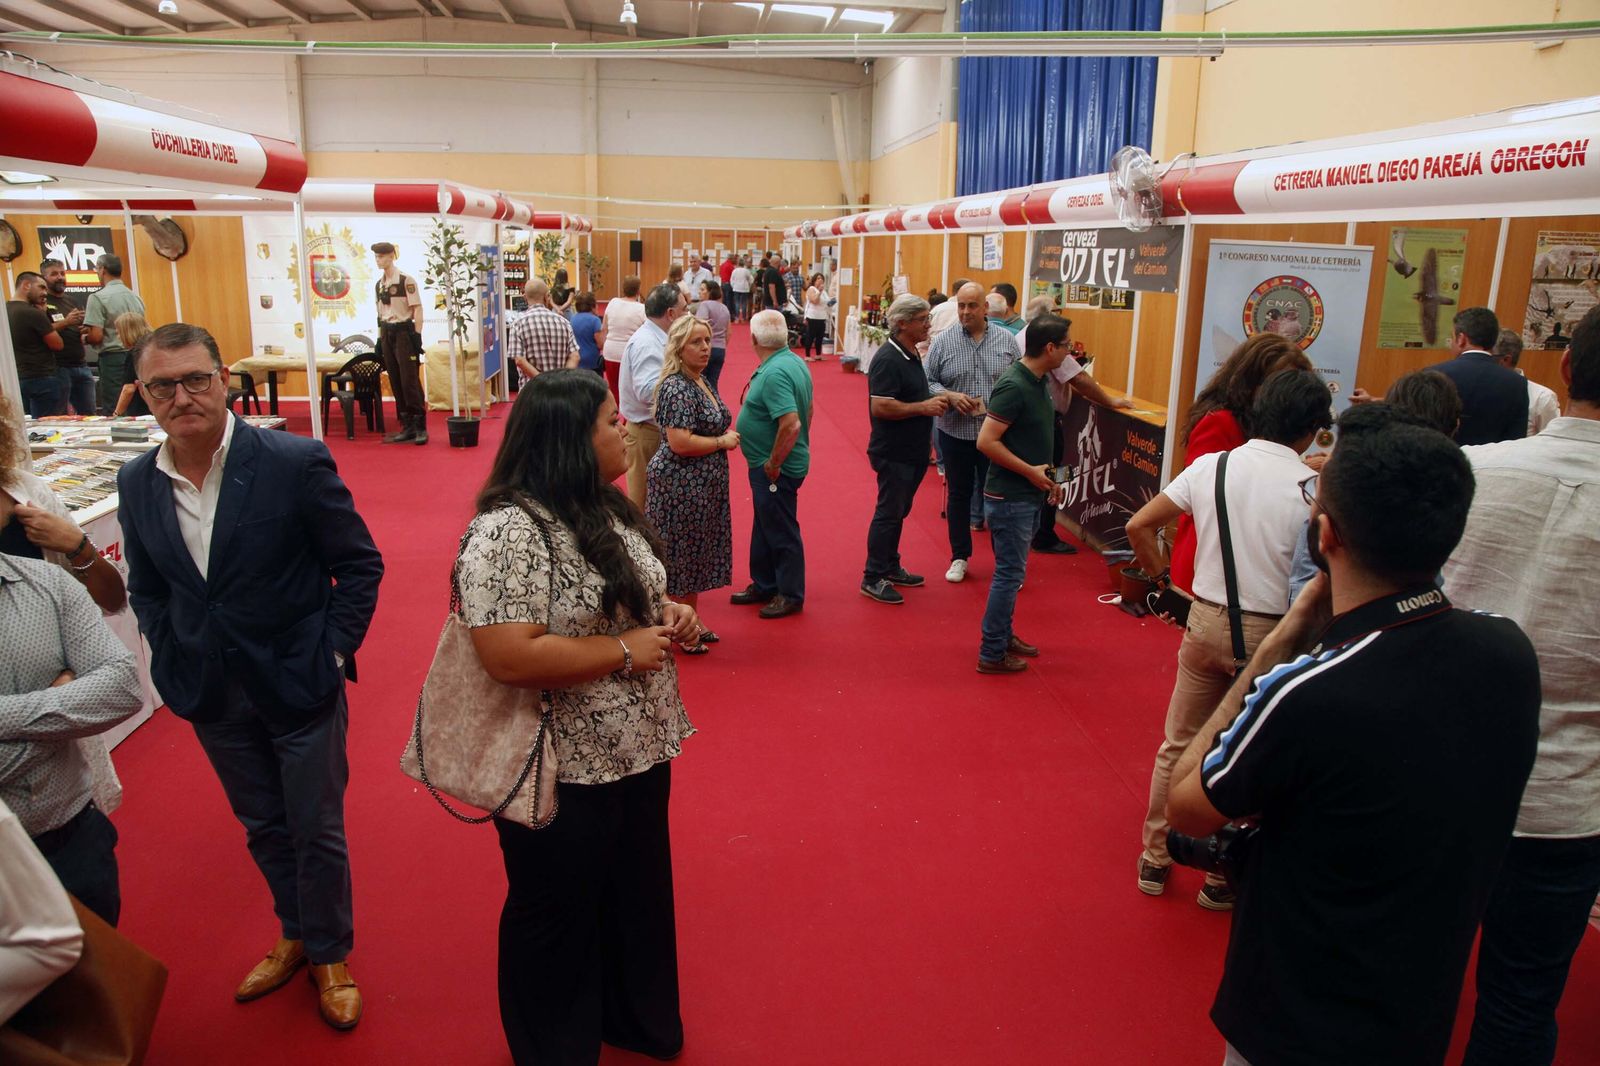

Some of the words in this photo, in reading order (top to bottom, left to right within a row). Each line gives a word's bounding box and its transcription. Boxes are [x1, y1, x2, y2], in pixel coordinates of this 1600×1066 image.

[151, 130, 211, 159] CUCHILLERIA
[212, 142, 238, 164] CUREL
[1273, 168, 1323, 191] CETRERIA
[1326, 164, 1374, 187] MANUEL
[1377, 158, 1419, 183] DIEGO
[1423, 151, 1483, 179] PAREJA
[1490, 138, 1590, 174] OBREGON
[1067, 195, 1089, 208] CERVEZAS
[1090, 193, 1104, 206] ODIEL
[1062, 229, 1098, 247] cerveza
[1139, 243, 1168, 257] Valverde
[1228, 252, 1269, 262] CONGRESO
[1270, 254, 1309, 264] NACIONAL
[1311, 256, 1322, 265] DE
[1322, 255, 1362, 267] CETRERÍA
[1060, 248, 1130, 288] ODIEL
[1133, 262, 1144, 275] del
[1144, 261, 1168, 276] Camino
[1266, 300, 1303, 308] CNAC
[1127, 429, 1157, 456] Valverde
[1121, 447, 1132, 465] del
[1133, 452, 1159, 477] Camino
[1396, 589, 1442, 613] Canon
